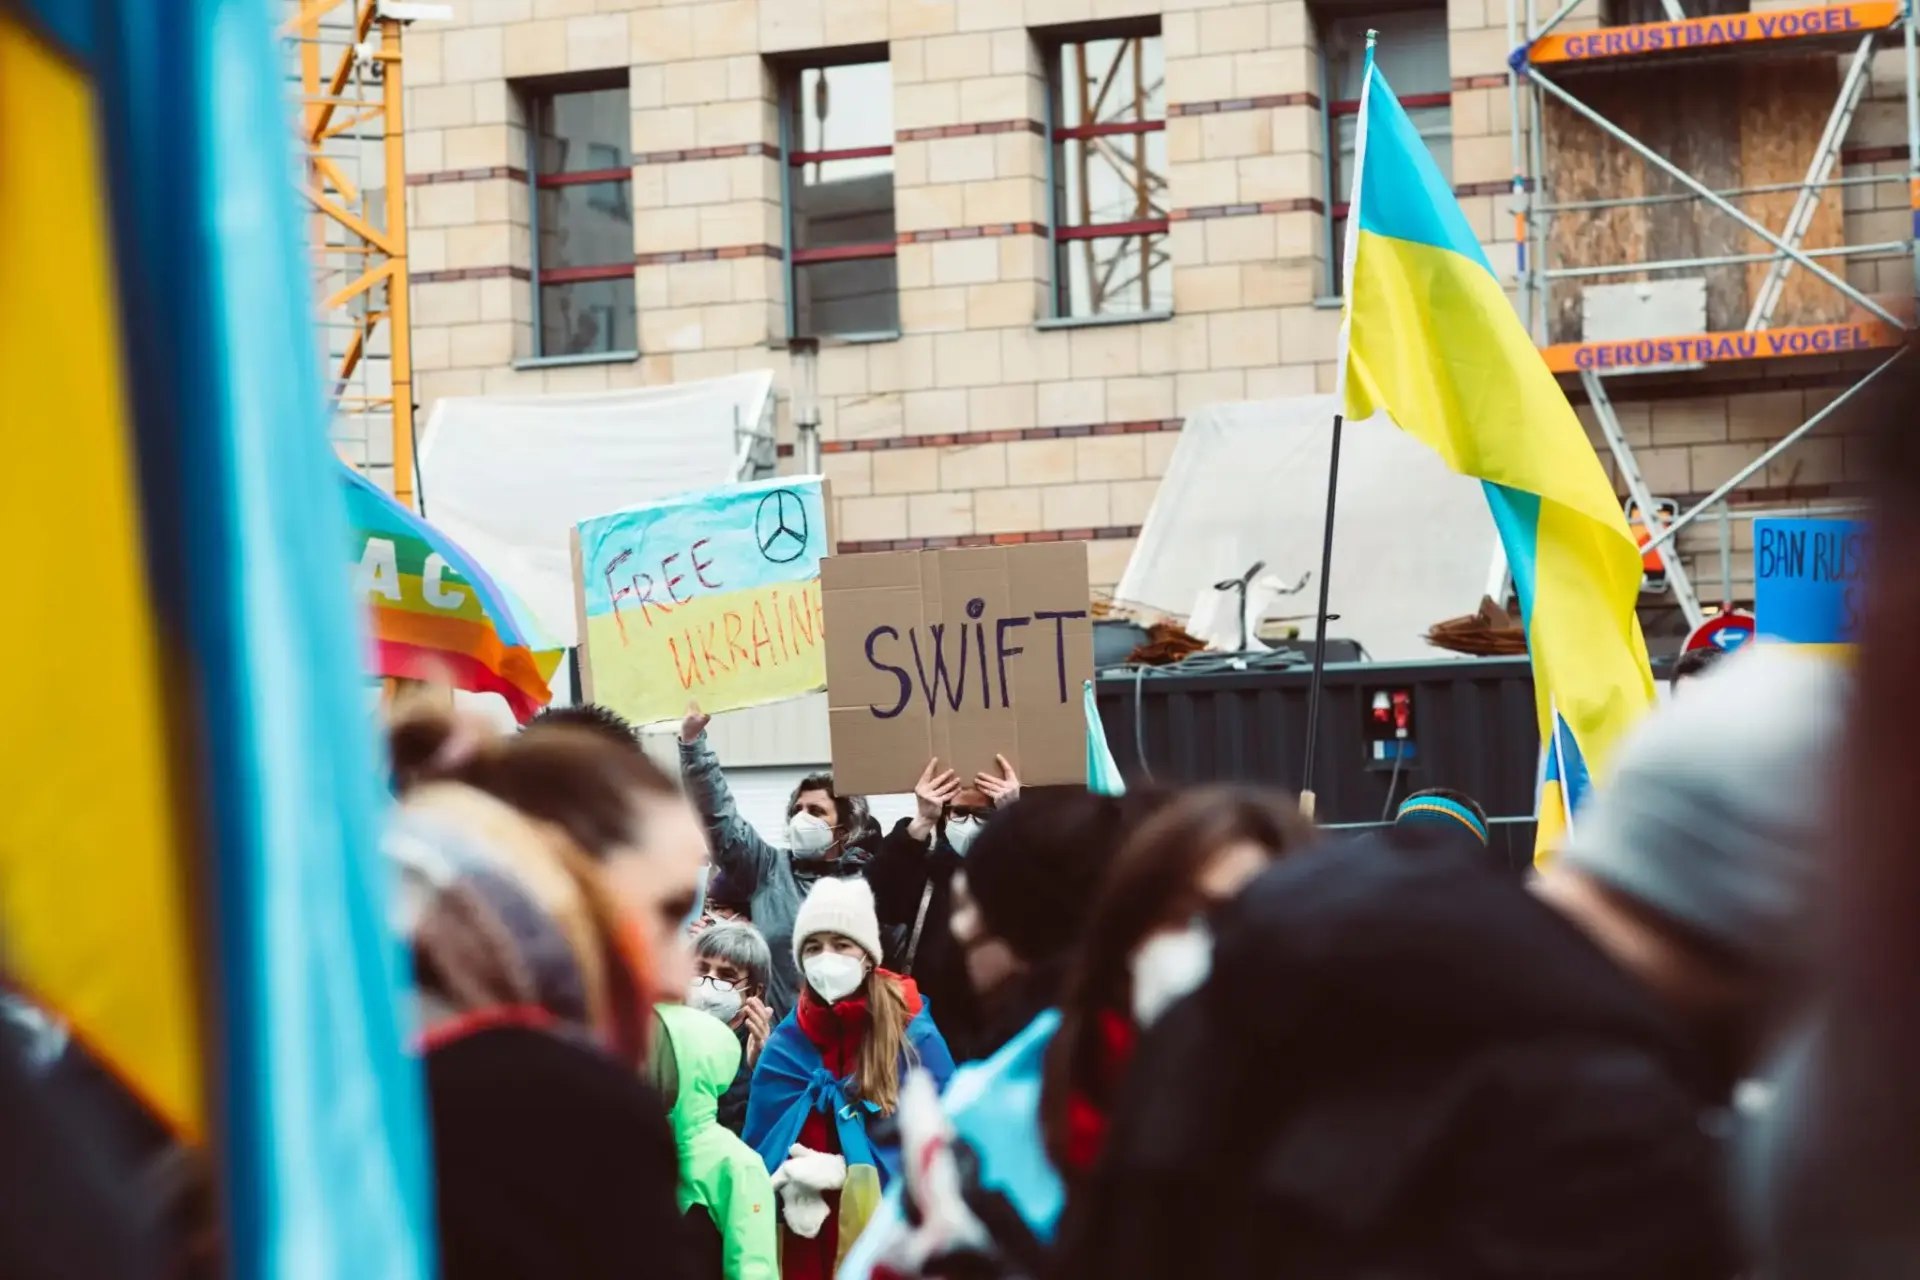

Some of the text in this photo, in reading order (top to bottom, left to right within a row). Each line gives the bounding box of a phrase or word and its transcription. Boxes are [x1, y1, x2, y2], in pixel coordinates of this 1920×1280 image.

[1564, 8, 1861, 58] GERÜSTBAU VOGEL
[1574, 327, 1870, 369] GERÜSTBAU VOGEL
[353, 536, 468, 610] AC
[1760, 528, 1866, 583] BAN RUS
[605, 538, 723, 647] FREE
